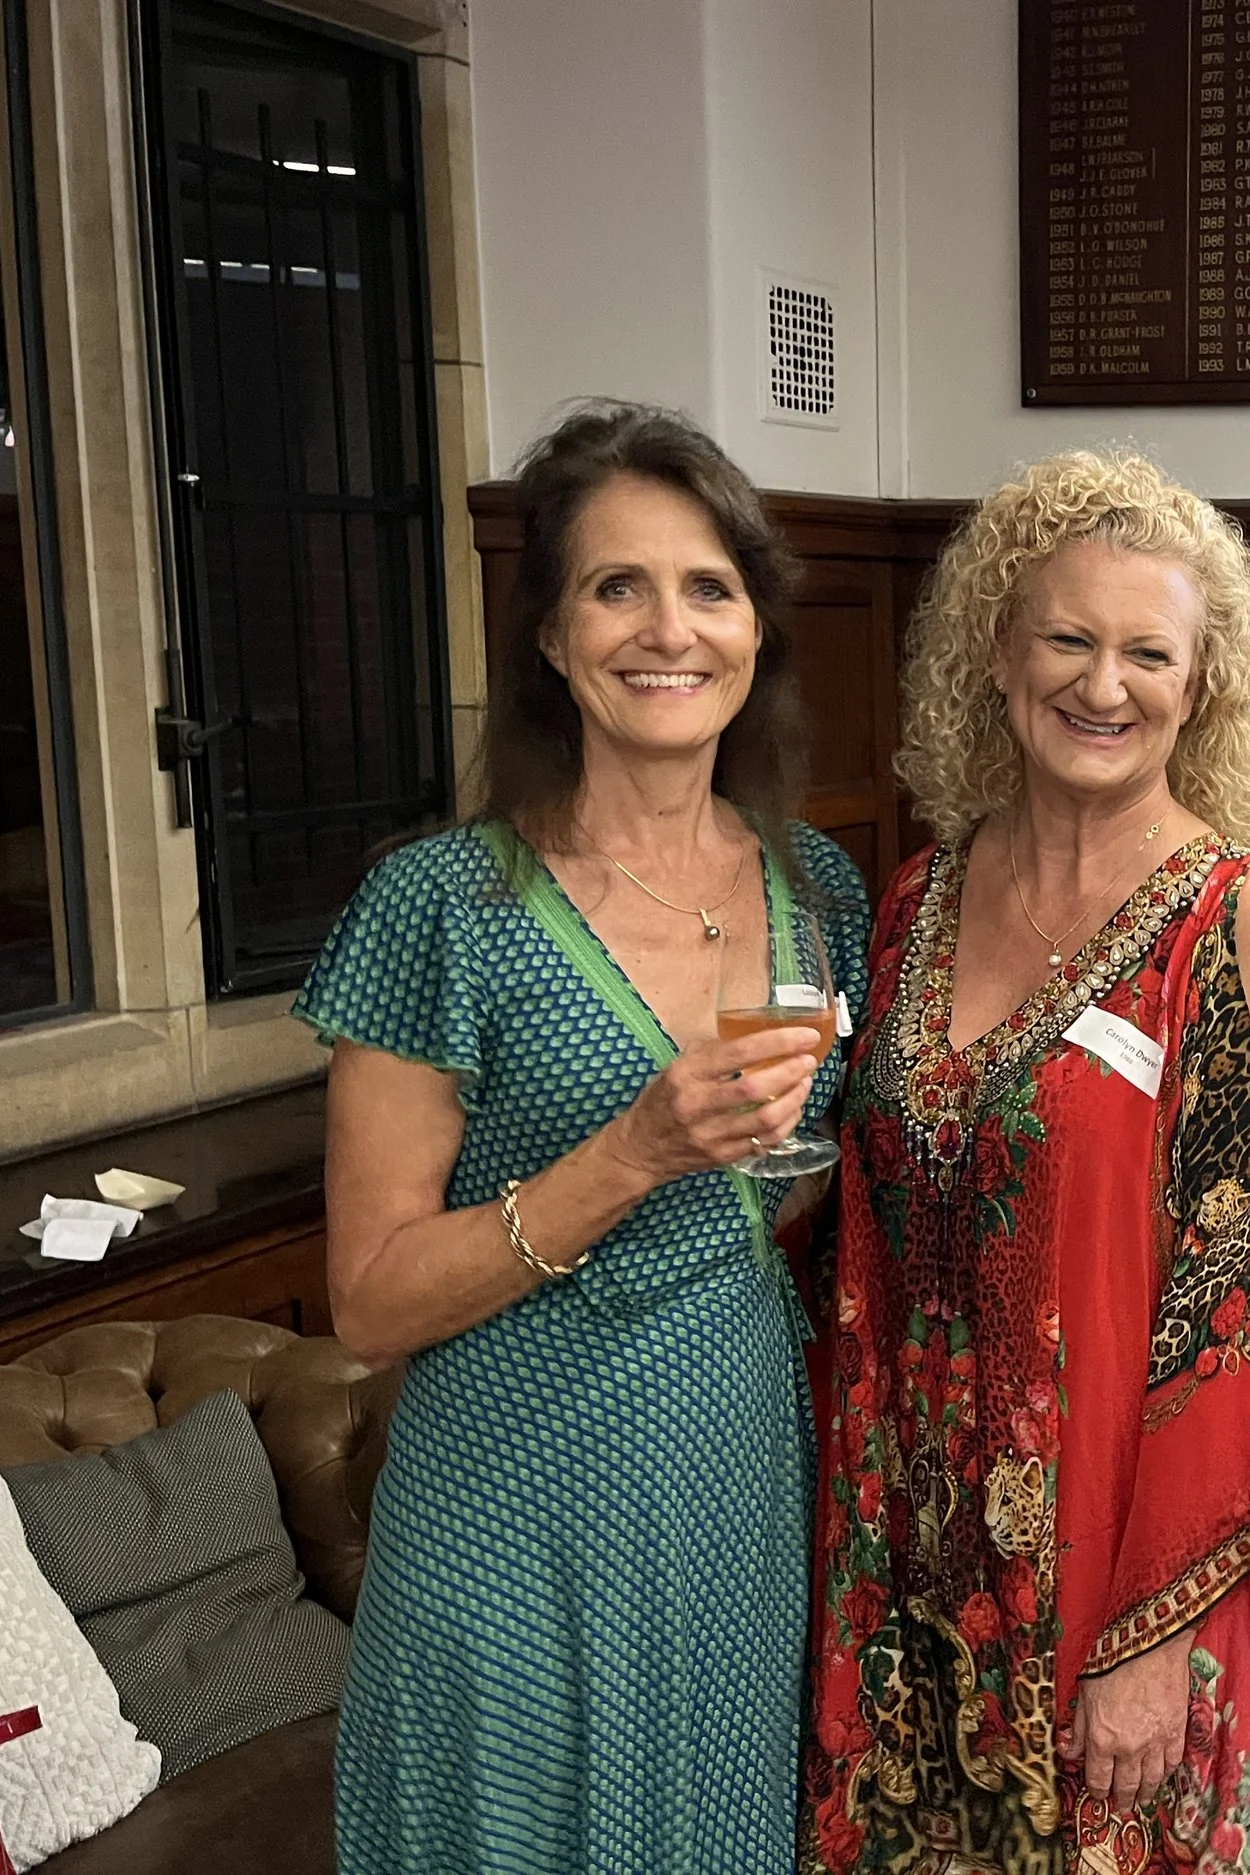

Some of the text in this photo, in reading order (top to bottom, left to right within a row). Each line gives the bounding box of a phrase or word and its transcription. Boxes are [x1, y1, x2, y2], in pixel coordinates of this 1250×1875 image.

[1202, 14, 1224, 28] 1974
[1202, 33, 1224, 47] 1975
[1202, 52, 1225, 64] 1976
[1201, 70, 1224, 84] 1977
[1201, 87, 1224, 102] 1978
[1201, 106, 1224, 119] 1979
[1200, 123, 1225, 138] 1980
[1200, 141, 1222, 156] 1981
[1050, 188, 1075, 202] 1949
[1200, 197, 1226, 210] 1984
[1049, 206, 1075, 220] 1950
[1101, 202, 1138, 216] STONE
[1049, 224, 1074, 238] 1951
[1049, 241, 1075, 255] 1952
[1107, 236, 1148, 251] WILSON
[1050, 257, 1075, 271] 1953
[1106, 255, 1142, 269] HODGE
[1199, 251, 1224, 266] 1987
[1050, 275, 1074, 289] 1954
[1105, 272, 1140, 286] DANIEL
[1050, 294, 1075, 307] 1955
[1200, 287, 1224, 301] 1989
[1199, 306, 1225, 320] 1990
[1050, 328, 1075, 341] 1957
[1199, 323, 1221, 337] 1991
[1100, 345, 1140, 357] OLDHAM
[1199, 342, 1223, 355] 1992
[1050, 362, 1075, 375] 1959
[1101, 361, 1149, 374] MALCOLM
[1199, 359, 1224, 372] 1993
[1106, 1028, 1136, 1052] Carolyn
[1136, 1050, 1158, 1069] Dwyer
